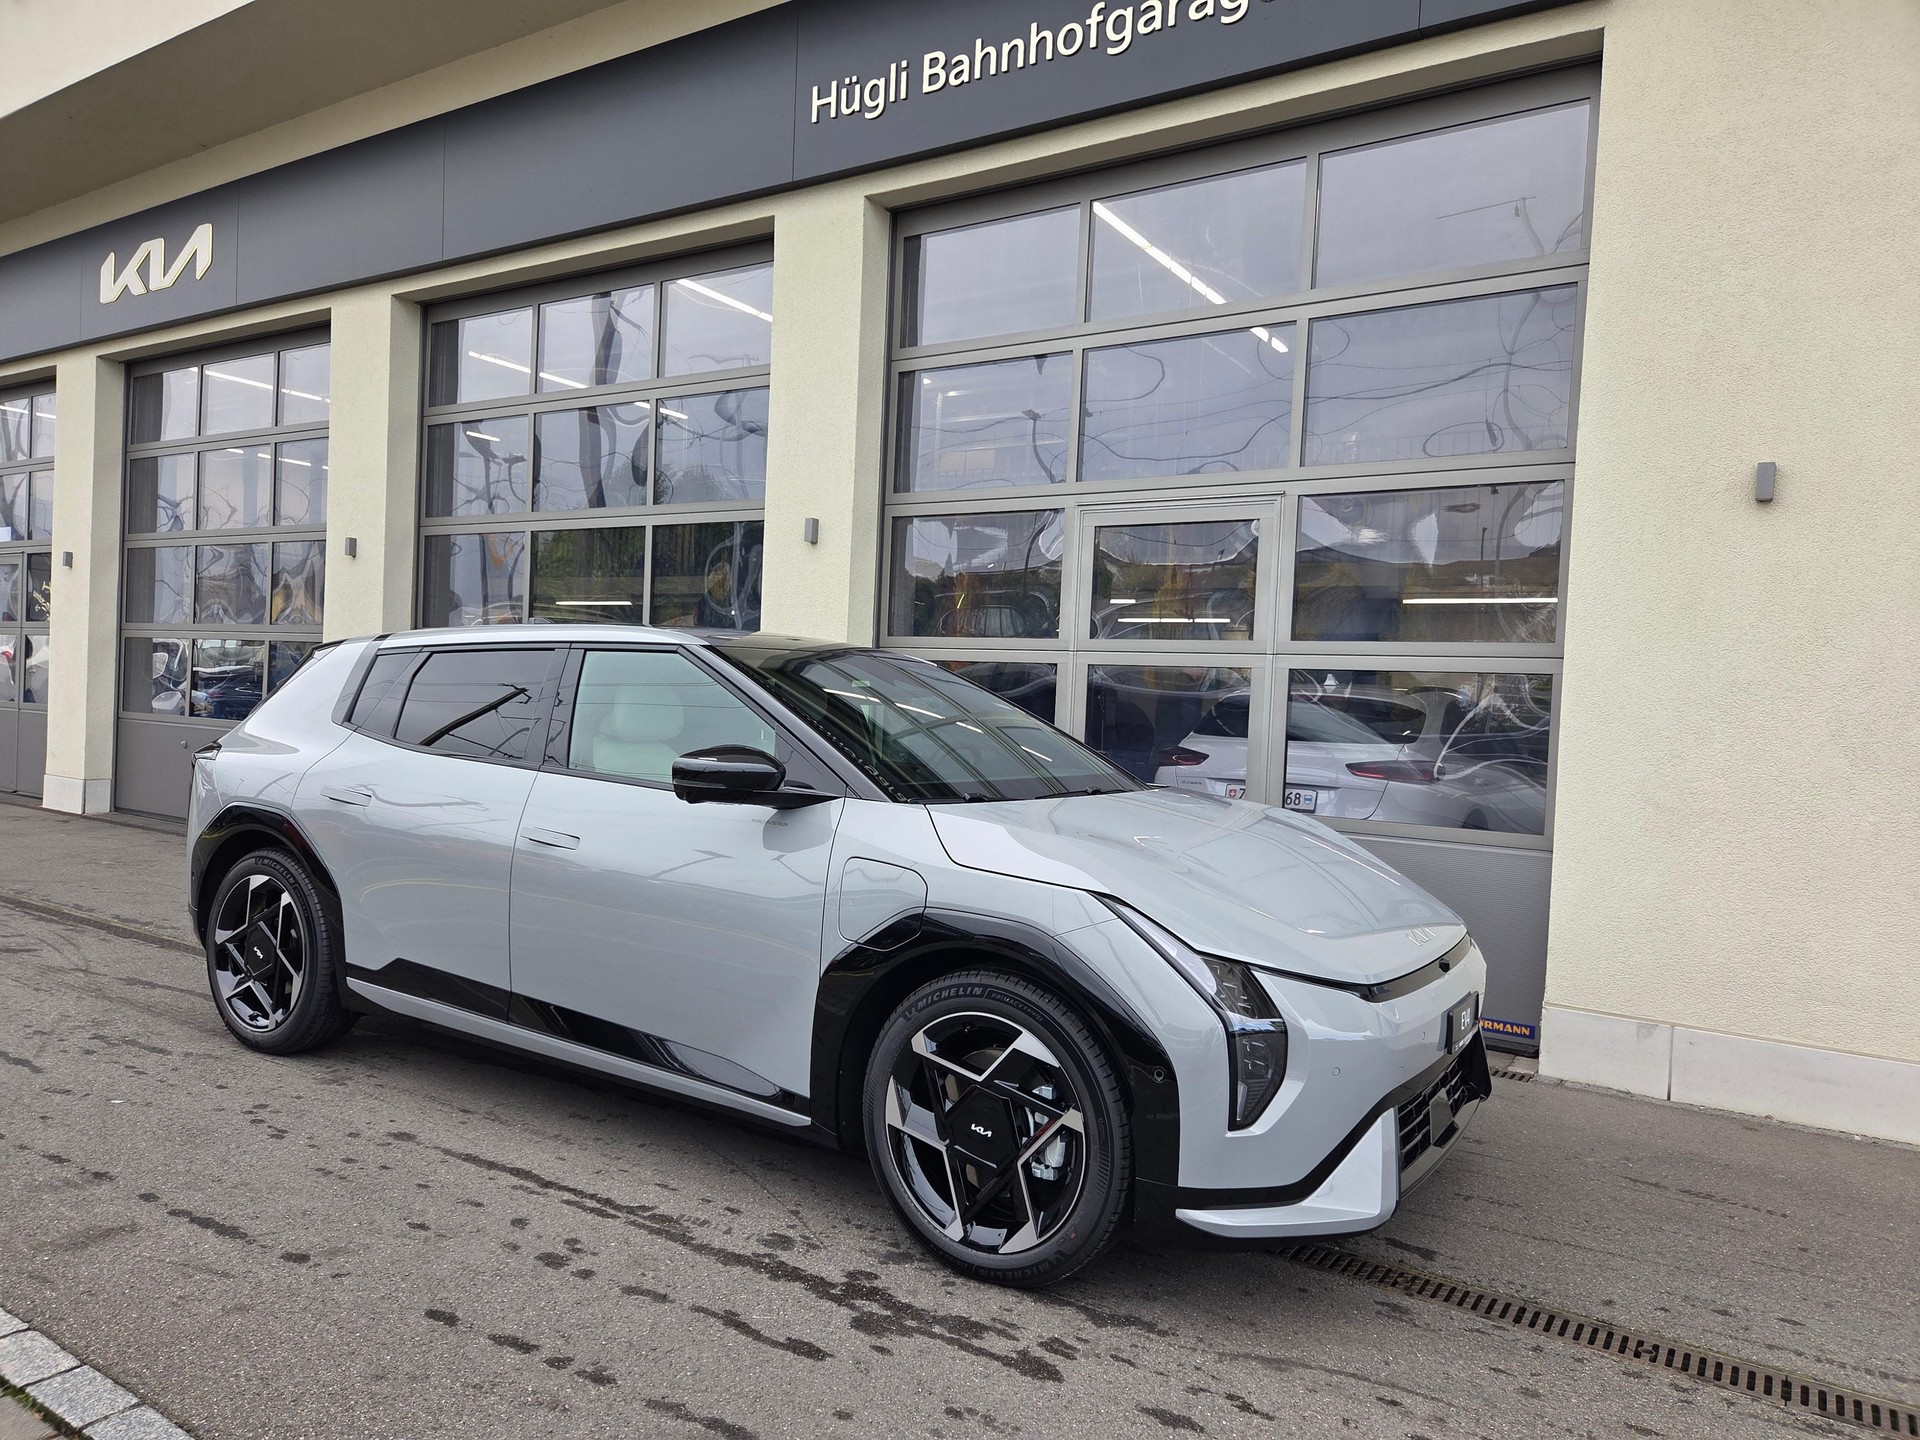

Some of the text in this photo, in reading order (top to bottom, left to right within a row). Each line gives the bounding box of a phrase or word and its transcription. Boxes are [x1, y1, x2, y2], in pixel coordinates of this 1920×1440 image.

[811, 0, 1275, 123] Hügli Bahnhofgarag
[100, 223, 212, 304] KIA
[916, 986, 984, 1011] MICHELIN
